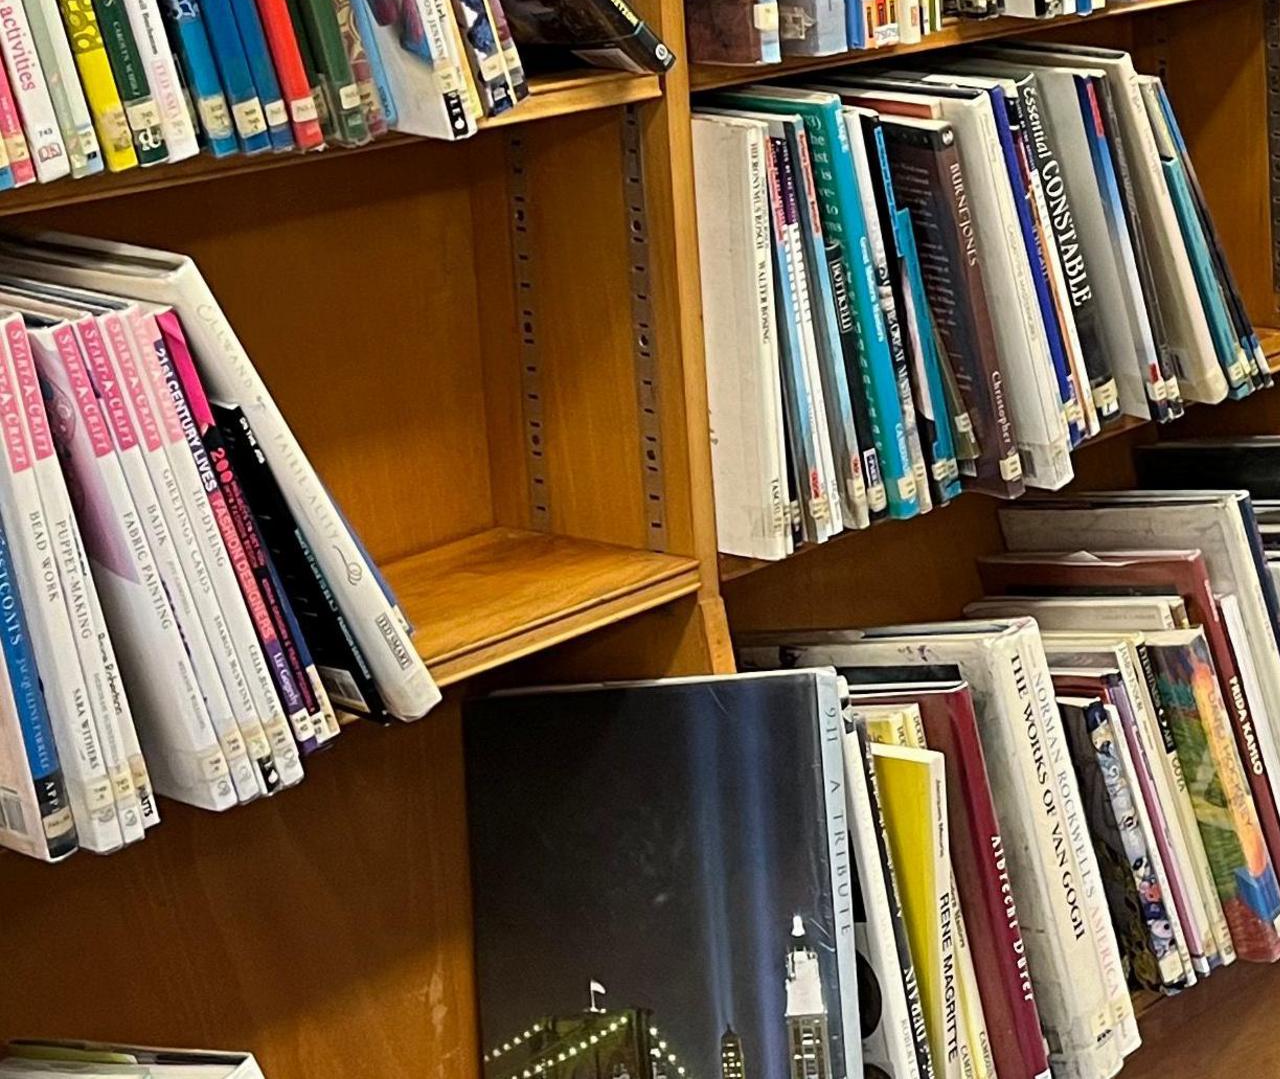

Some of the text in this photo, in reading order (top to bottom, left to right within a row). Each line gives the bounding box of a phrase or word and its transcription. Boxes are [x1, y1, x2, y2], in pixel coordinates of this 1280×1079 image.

[0, 5, 37, 93] activities
[1022, 86, 1093, 308] Essential CONSTABLE
[949, 163, 1012, 445] BURNE-JONES Christopher
[10, 327, 48, 457] START-A-CRAFT
[58, 333, 110, 457] START-A-CRAFT
[84, 328, 135, 446] START-A-CRAFT
[109, 323, 160, 450] START-A-CRAFT
[166, 379, 207, 457] CENTURY
[194, 448, 218, 493] LIVES
[209, 446, 234, 483] 200
[29, 510, 60, 604] BEAD WORK
[122, 510, 173, 631] FABRIC PAINTING
[147, 503, 168, 548] BATIK
[162, 467, 212, 595] GREETINGS CARDS
[191, 488, 226, 569] TIE-DYEING
[211, 500, 244, 563] FASHION
[55, 519, 100, 770] PUPPET-MAKING SARA WITHERS
[234, 556, 274, 640] DESIGNERS
[378, 614, 411, 673] TED SMART
[272, 651, 285, 672] Liz
[277, 668, 300, 708] Gogerly
[1228, 674, 1264, 777] FRIDA KAHLO
[1010, 652, 1087, 942] THE WORKS OF VAN GOGH
[829, 780, 853, 938] A TRIBUTE
[939, 891, 959, 1064] RENE MAGRITTE
